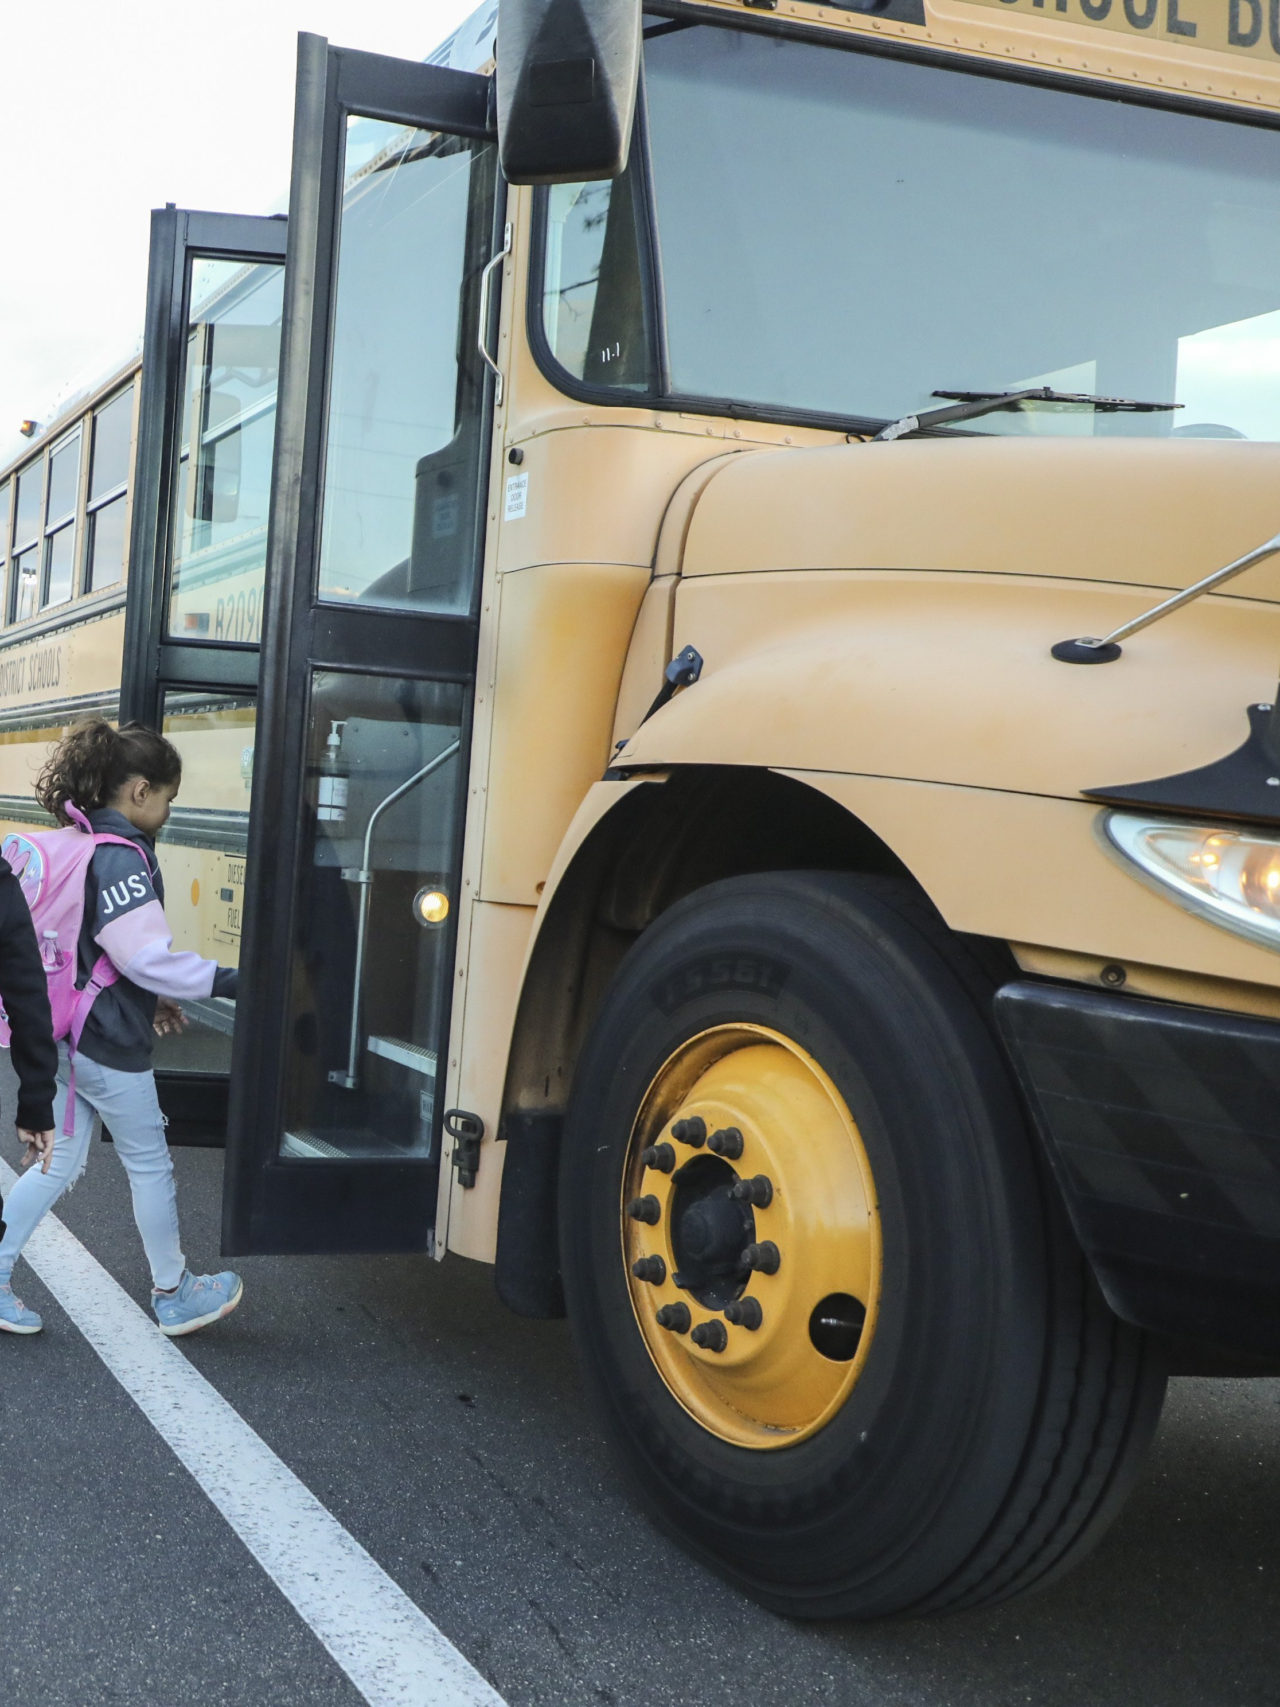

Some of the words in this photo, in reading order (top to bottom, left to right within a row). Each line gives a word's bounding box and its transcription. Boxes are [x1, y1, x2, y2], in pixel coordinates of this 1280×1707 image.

[508, 479, 527, 493] ENTRANCE
[28, 645, 62, 692] SCHOOLS
[227, 907, 241, 930] FUEL
